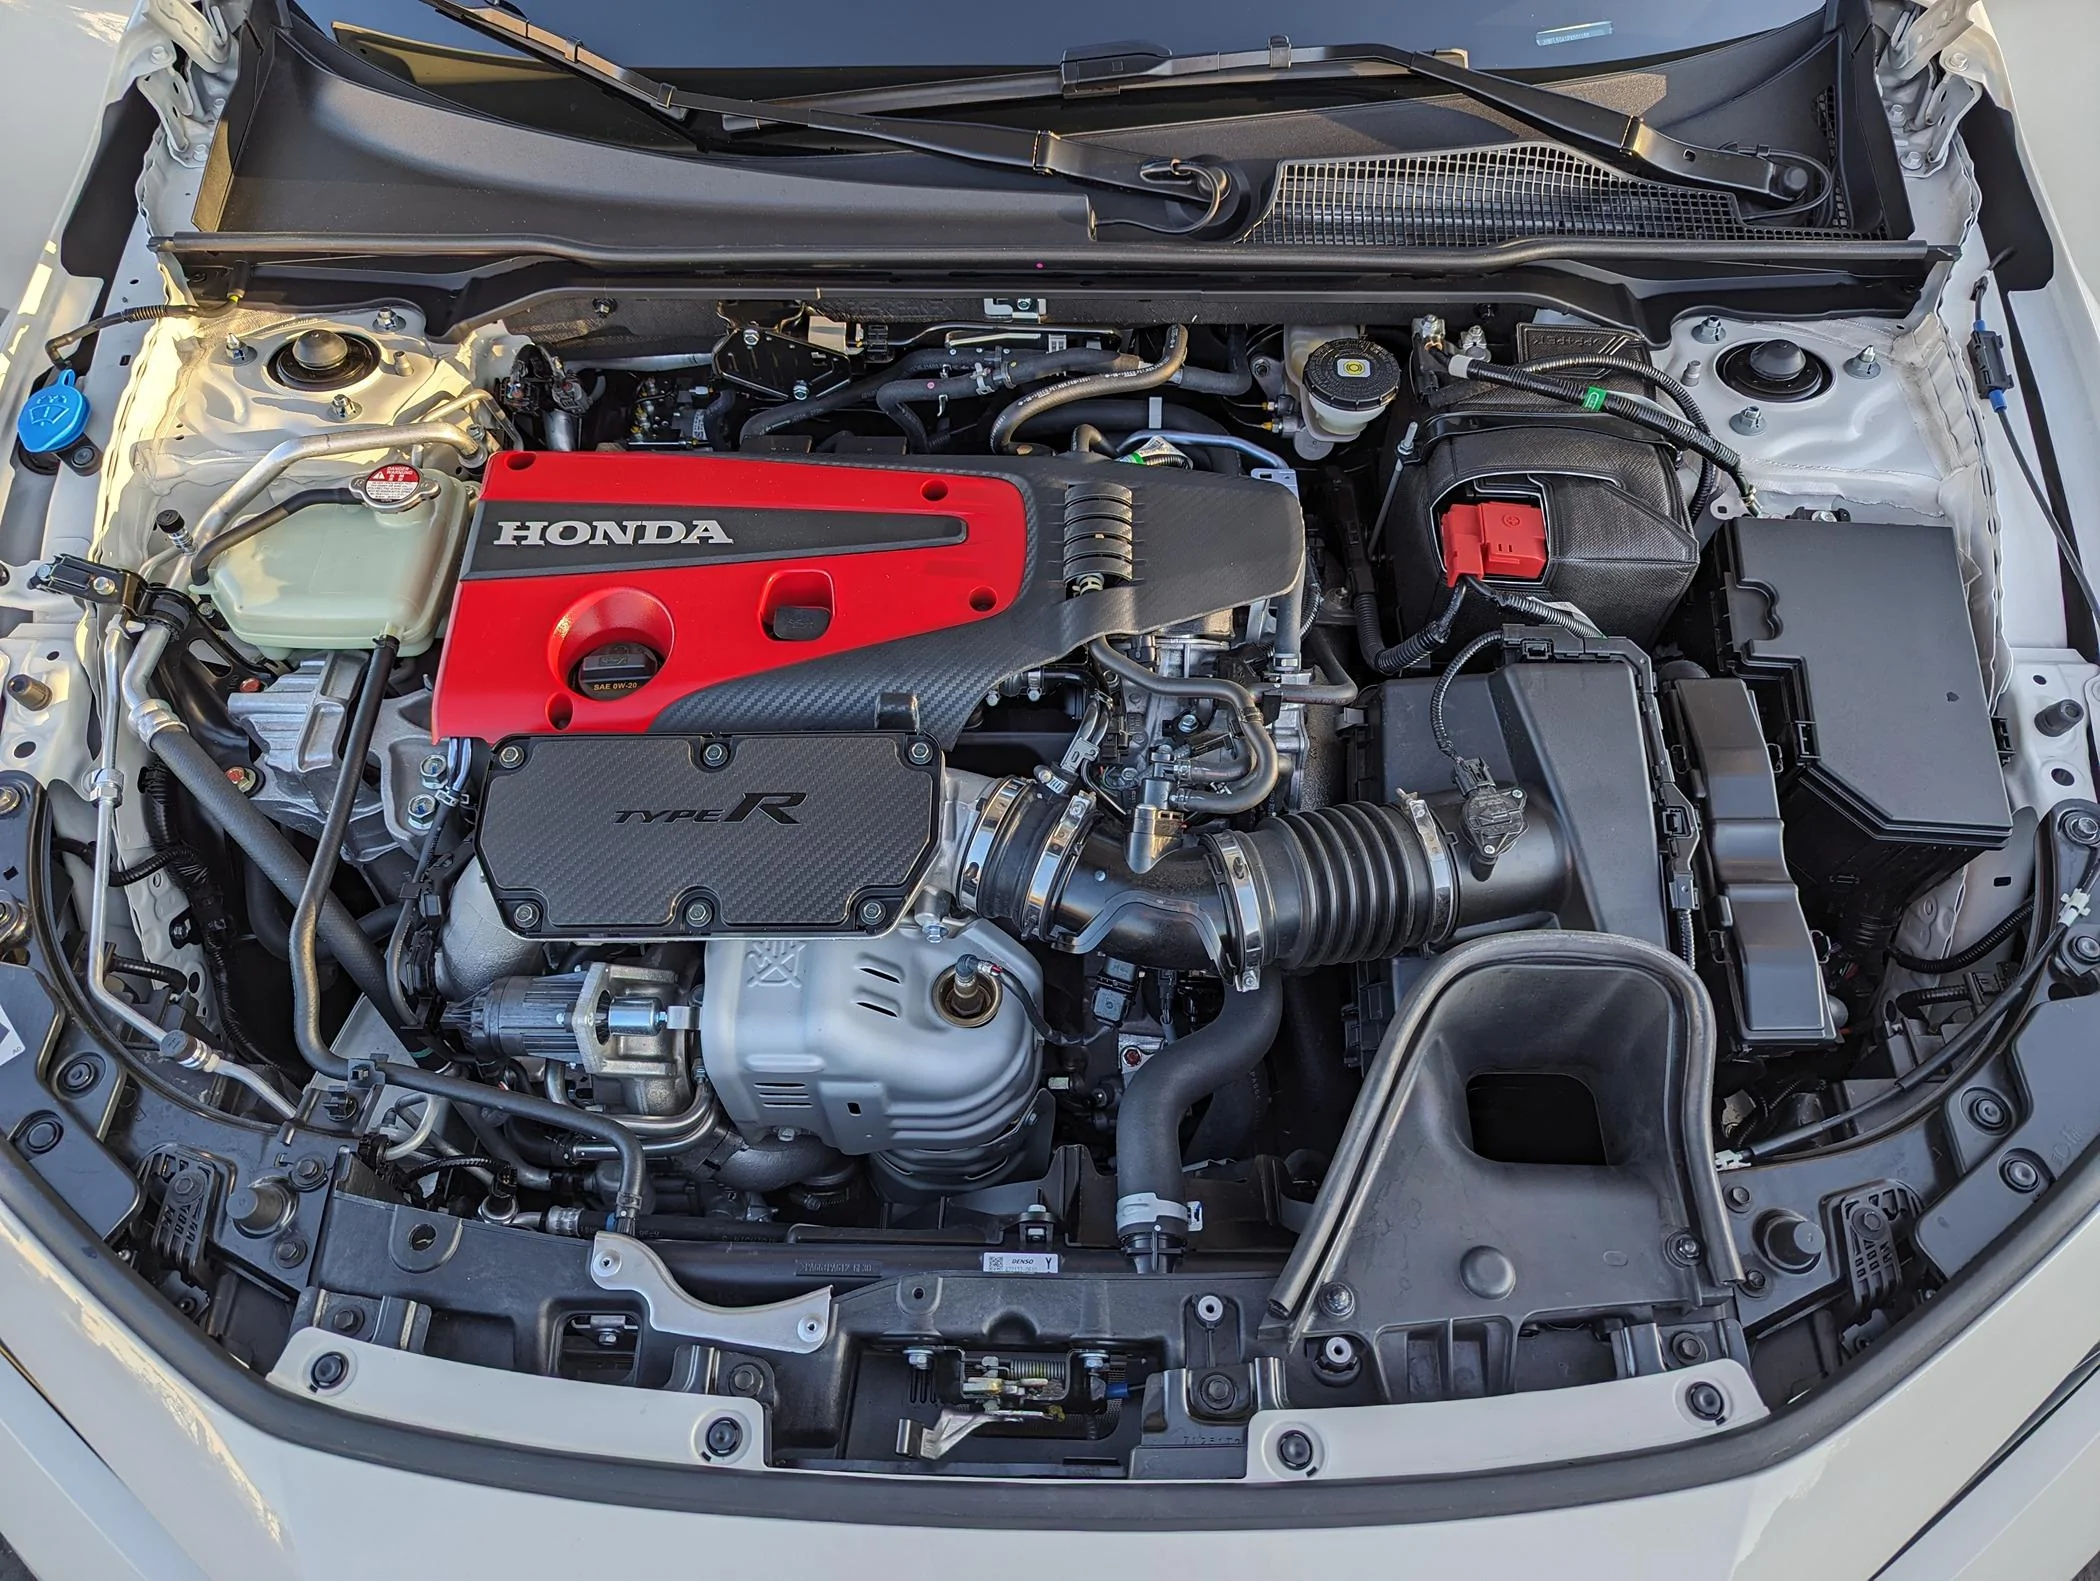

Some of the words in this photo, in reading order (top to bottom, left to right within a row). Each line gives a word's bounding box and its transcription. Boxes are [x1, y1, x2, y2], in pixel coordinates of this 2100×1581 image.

[493, 520, 734, 546] HONDA
[594, 683, 610, 691] SAE
[613, 682, 638, 690] 0W-20
[613, 809, 725, 825] TYPE
[721, 792, 809, 826] R
[1045, 1257, 1052, 1270] Y
